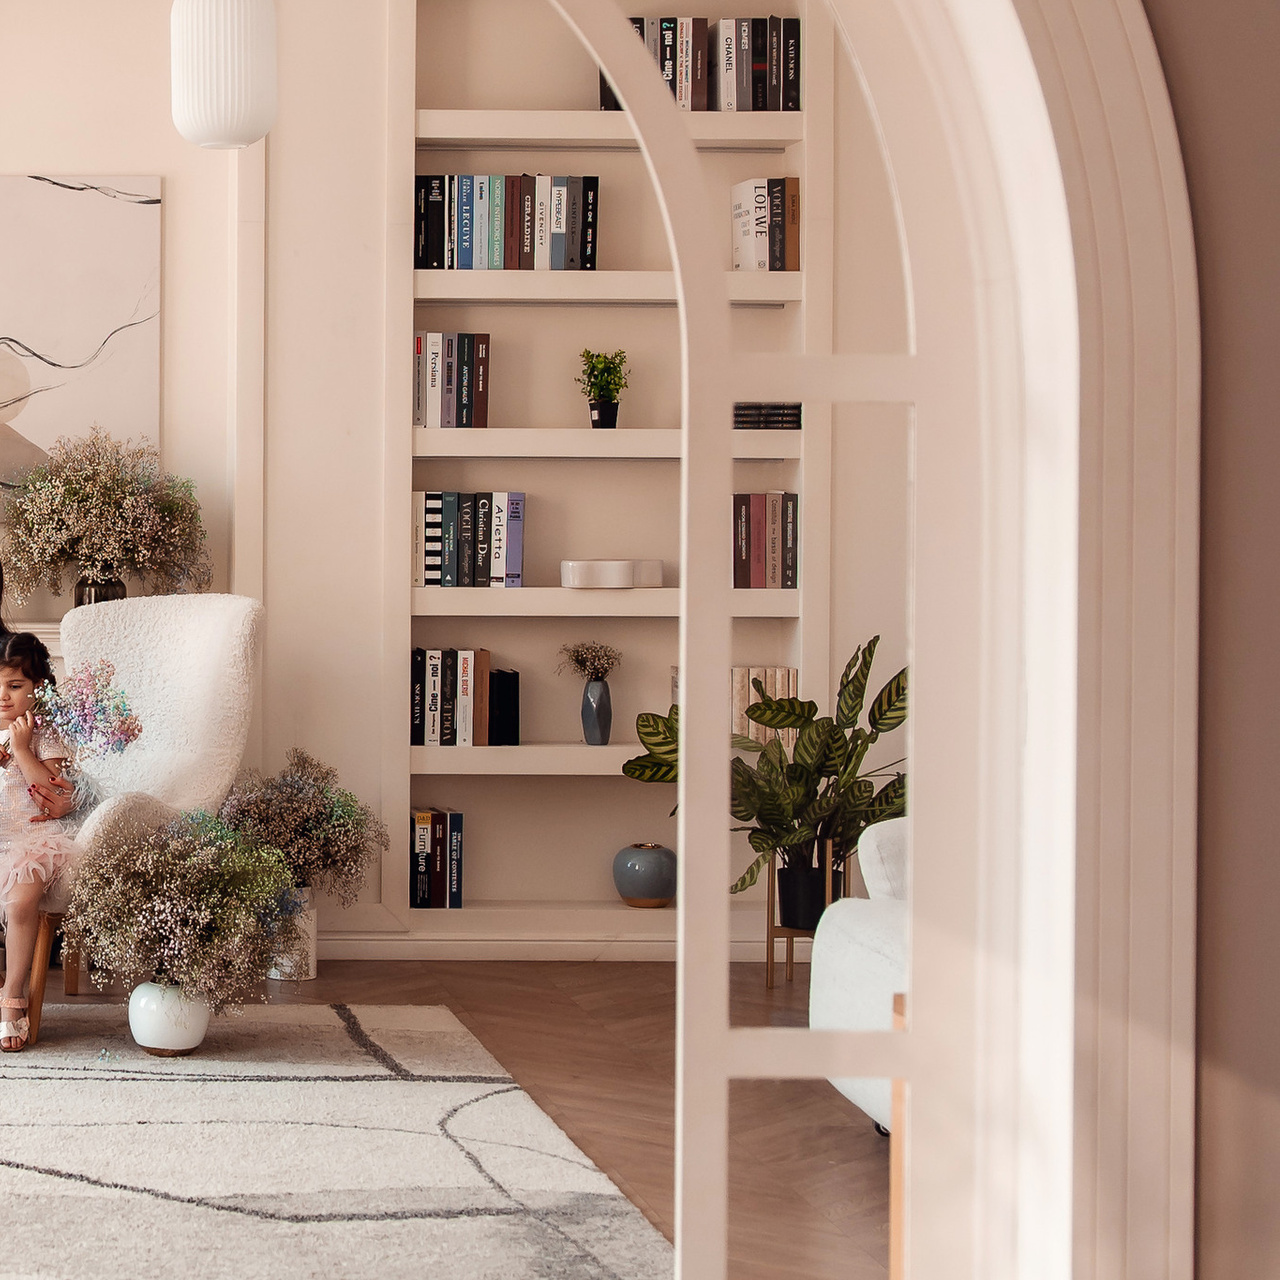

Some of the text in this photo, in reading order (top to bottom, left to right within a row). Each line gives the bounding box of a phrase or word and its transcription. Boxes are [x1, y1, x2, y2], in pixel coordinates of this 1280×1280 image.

[662, 30, 673, 45] noi
[725, 36, 733, 73] CHANEL
[662, 60, 673, 81] Cine
[554, 189, 563, 230] HYPEBEAST
[754, 185, 767, 239] LOEWE
[772, 186, 782, 226] VOGUE
[430, 351, 439, 389] Persiana
[462, 501, 472, 541] VOGUE
[476, 499, 489, 567] Christian Dior
[494, 504, 504, 560] Arletta
[770, 563, 778, 584] design
[428, 663, 439, 678] noi
[428, 692, 439, 713] Cine
[442, 700, 453, 741] VOGUE
[418, 826, 429, 873] Furniture
